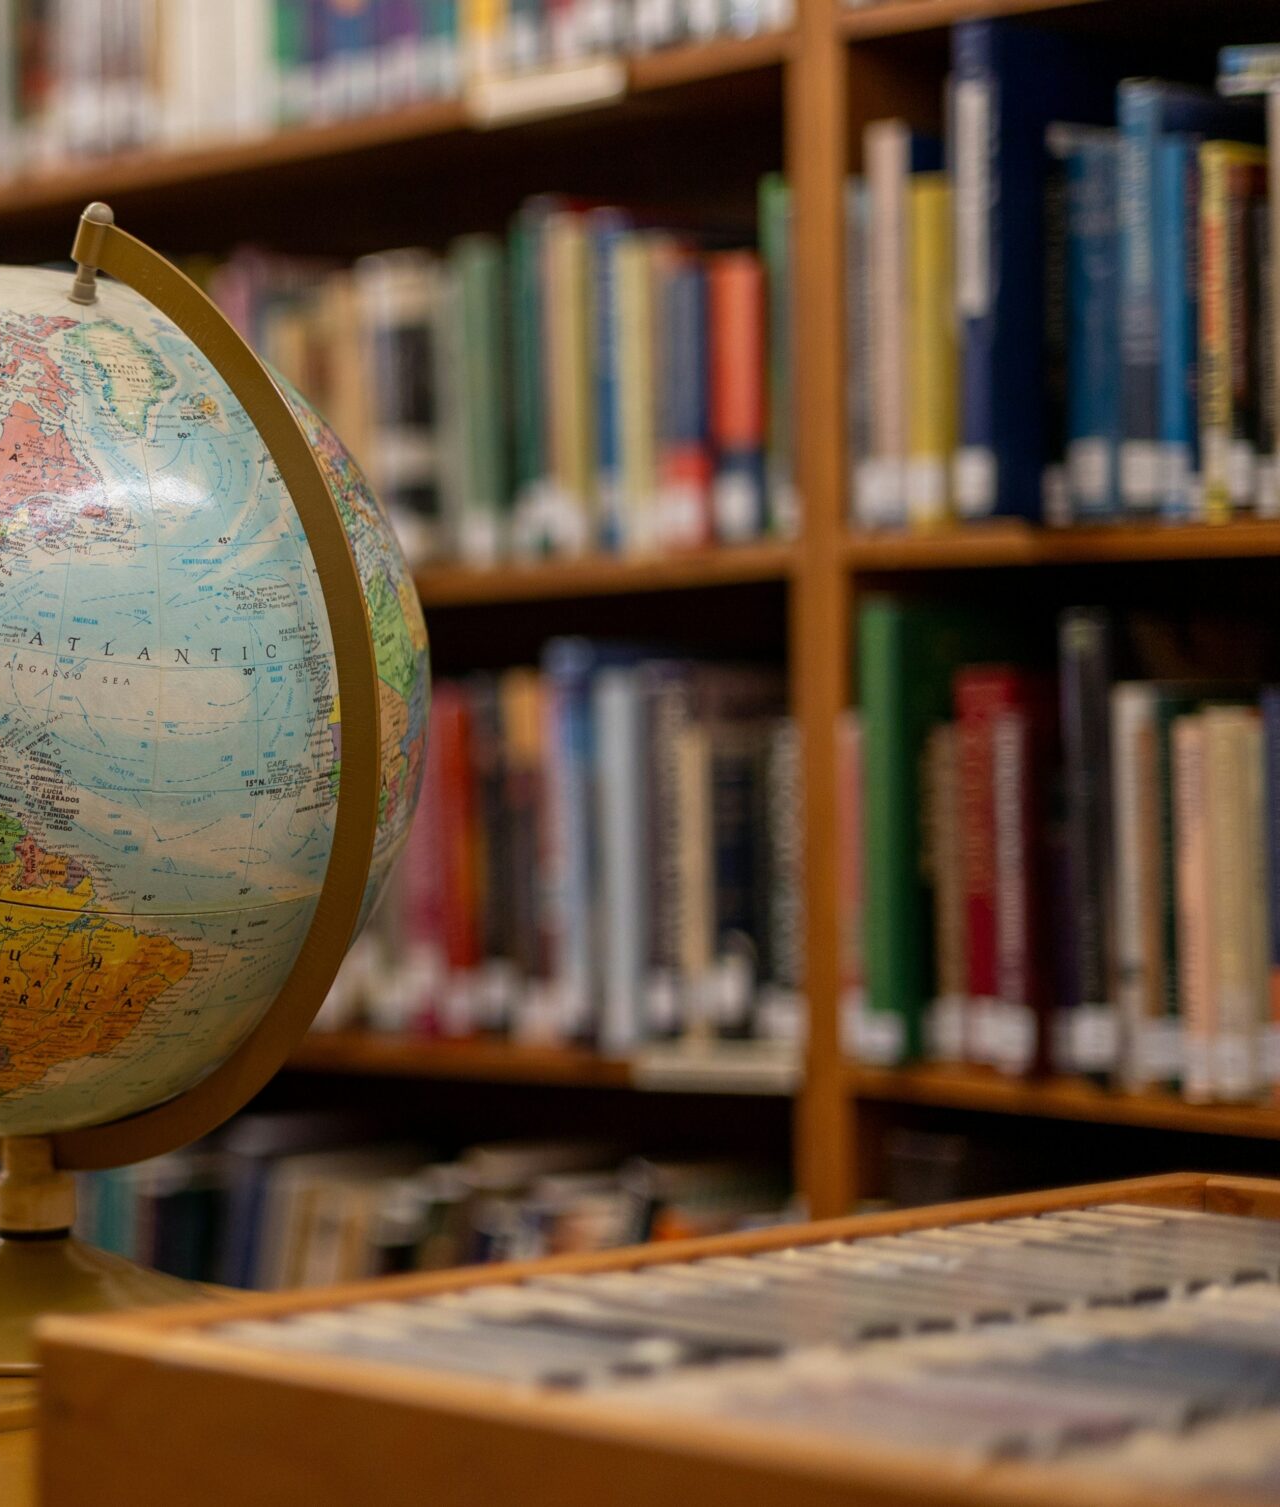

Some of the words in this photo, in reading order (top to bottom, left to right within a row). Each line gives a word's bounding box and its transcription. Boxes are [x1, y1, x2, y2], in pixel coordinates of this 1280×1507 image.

[237, 602, 268, 610] AZORES
[73, 616, 98, 625] AMERICAN
[29, 631, 277, 664] ATLANTIC
[288, 661, 317, 670] CANARY
[102, 676, 130, 685] SEA
[31, 775, 64, 784] DOMINICA
[268, 775, 293, 784] VERDE
[41, 794, 80, 803] BARBADOS
[270, 790, 301, 800] ISLANDS
[43, 812, 74, 820] TRINIDAD
[28, 844, 36, 874] GUYANA
